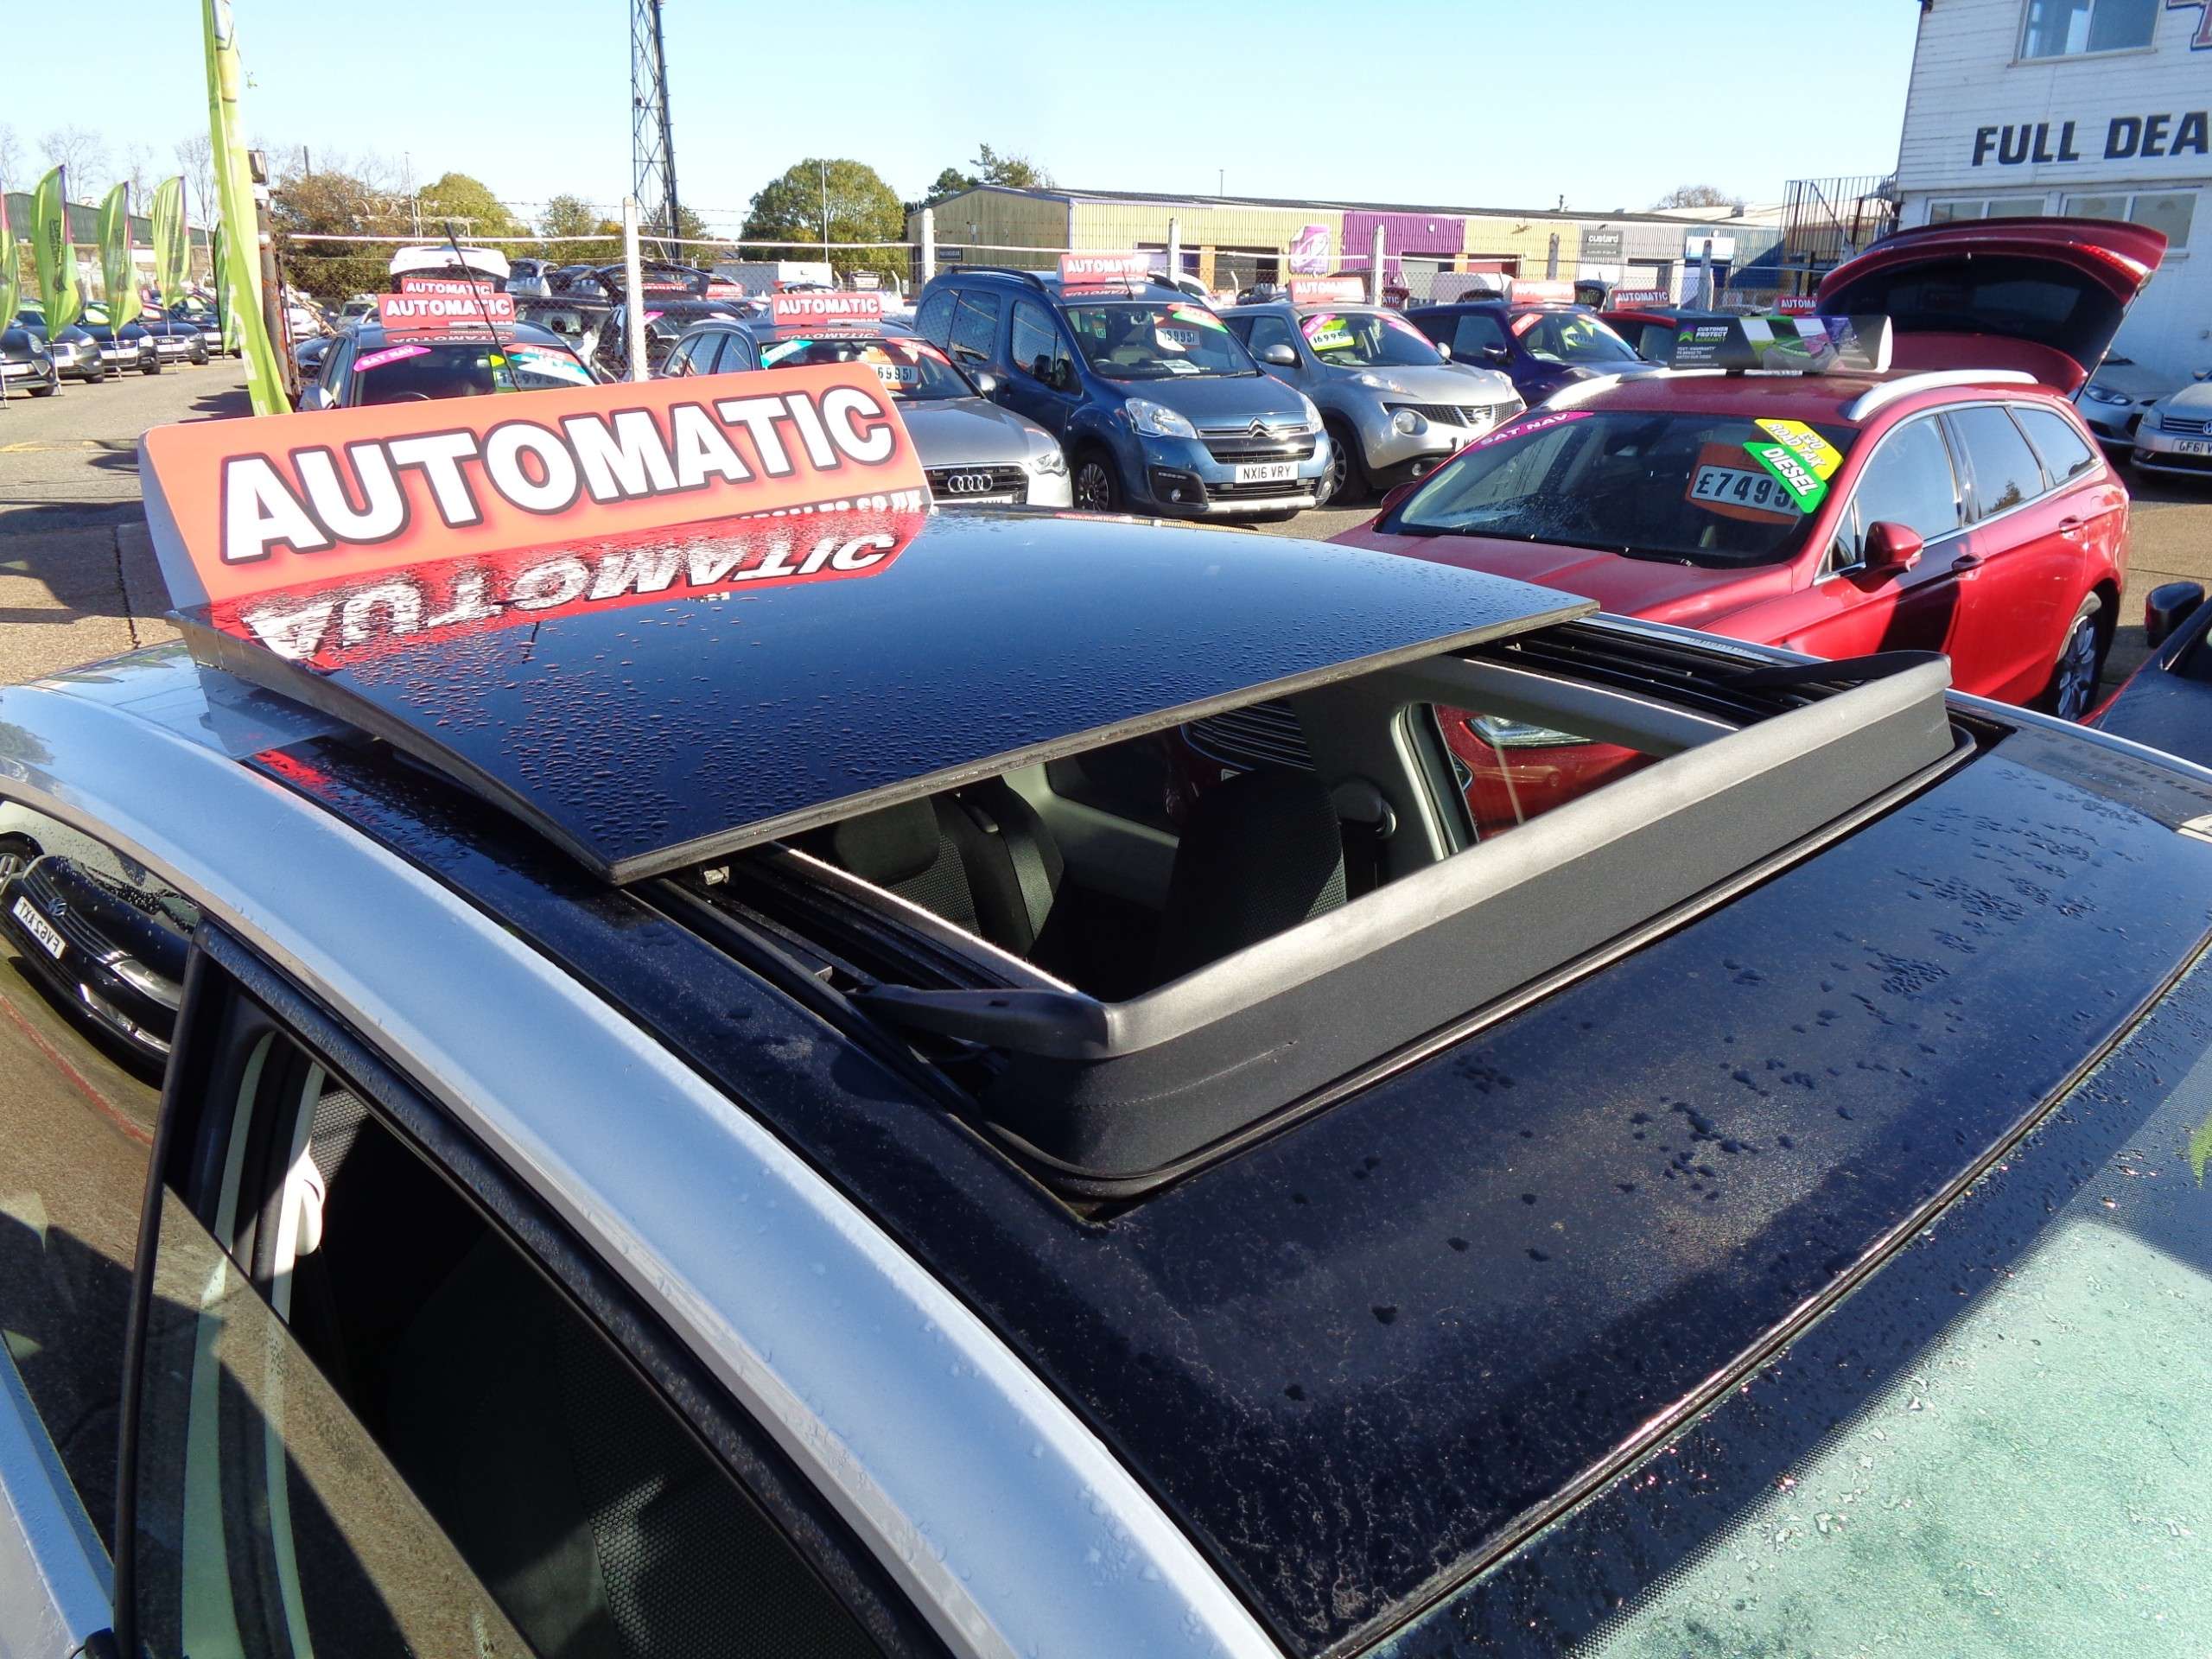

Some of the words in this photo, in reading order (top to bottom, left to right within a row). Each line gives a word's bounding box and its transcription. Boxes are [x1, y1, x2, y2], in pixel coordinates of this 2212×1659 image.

[1972, 121, 2080, 167] FULL
[2103, 111, 2209, 160] DEA
[405, 282, 491, 296] AUTOMATIC
[1616, 291, 1669, 302] AUTOMATIC
[385, 298, 512, 317] AUTOMATIC
[779, 298, 879, 315] AUTOMATIC
[1480, 427, 1521, 446] SAT
[1527, 413, 1570, 431] NAV
[1765, 423, 1802, 447] ROAD
[1797, 446, 1827, 469] TAX
[1800, 432, 1827, 450] £20
[2179, 442, 2204, 454] GF61
[224, 385, 896, 565] AUTOMATIC
[1243, 467, 1268, 480] NX16
[1271, 465, 1292, 478] VRY
[1761, 447, 1819, 497] DIESEL
